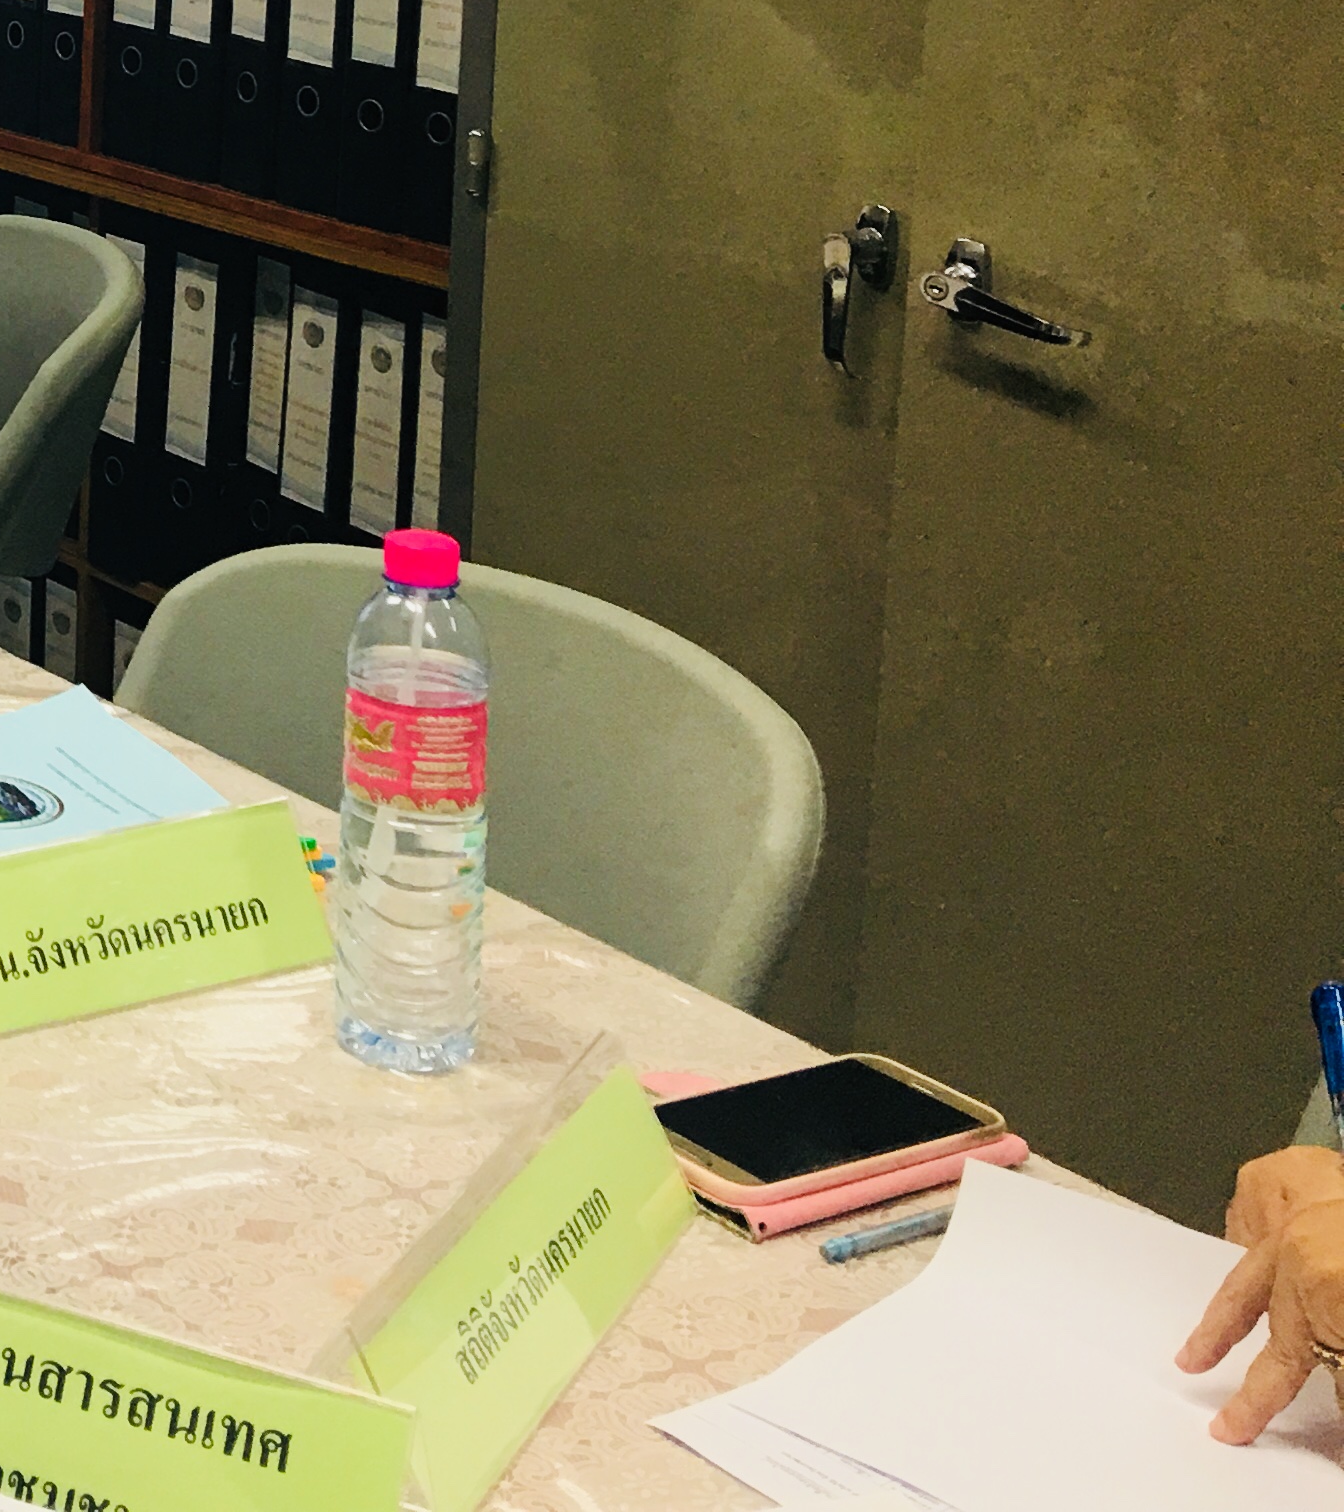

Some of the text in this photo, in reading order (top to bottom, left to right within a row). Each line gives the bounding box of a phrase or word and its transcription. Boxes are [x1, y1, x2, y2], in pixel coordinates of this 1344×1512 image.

[454, 1187, 612, 1386] สถิติจังหวัดนครนายก
